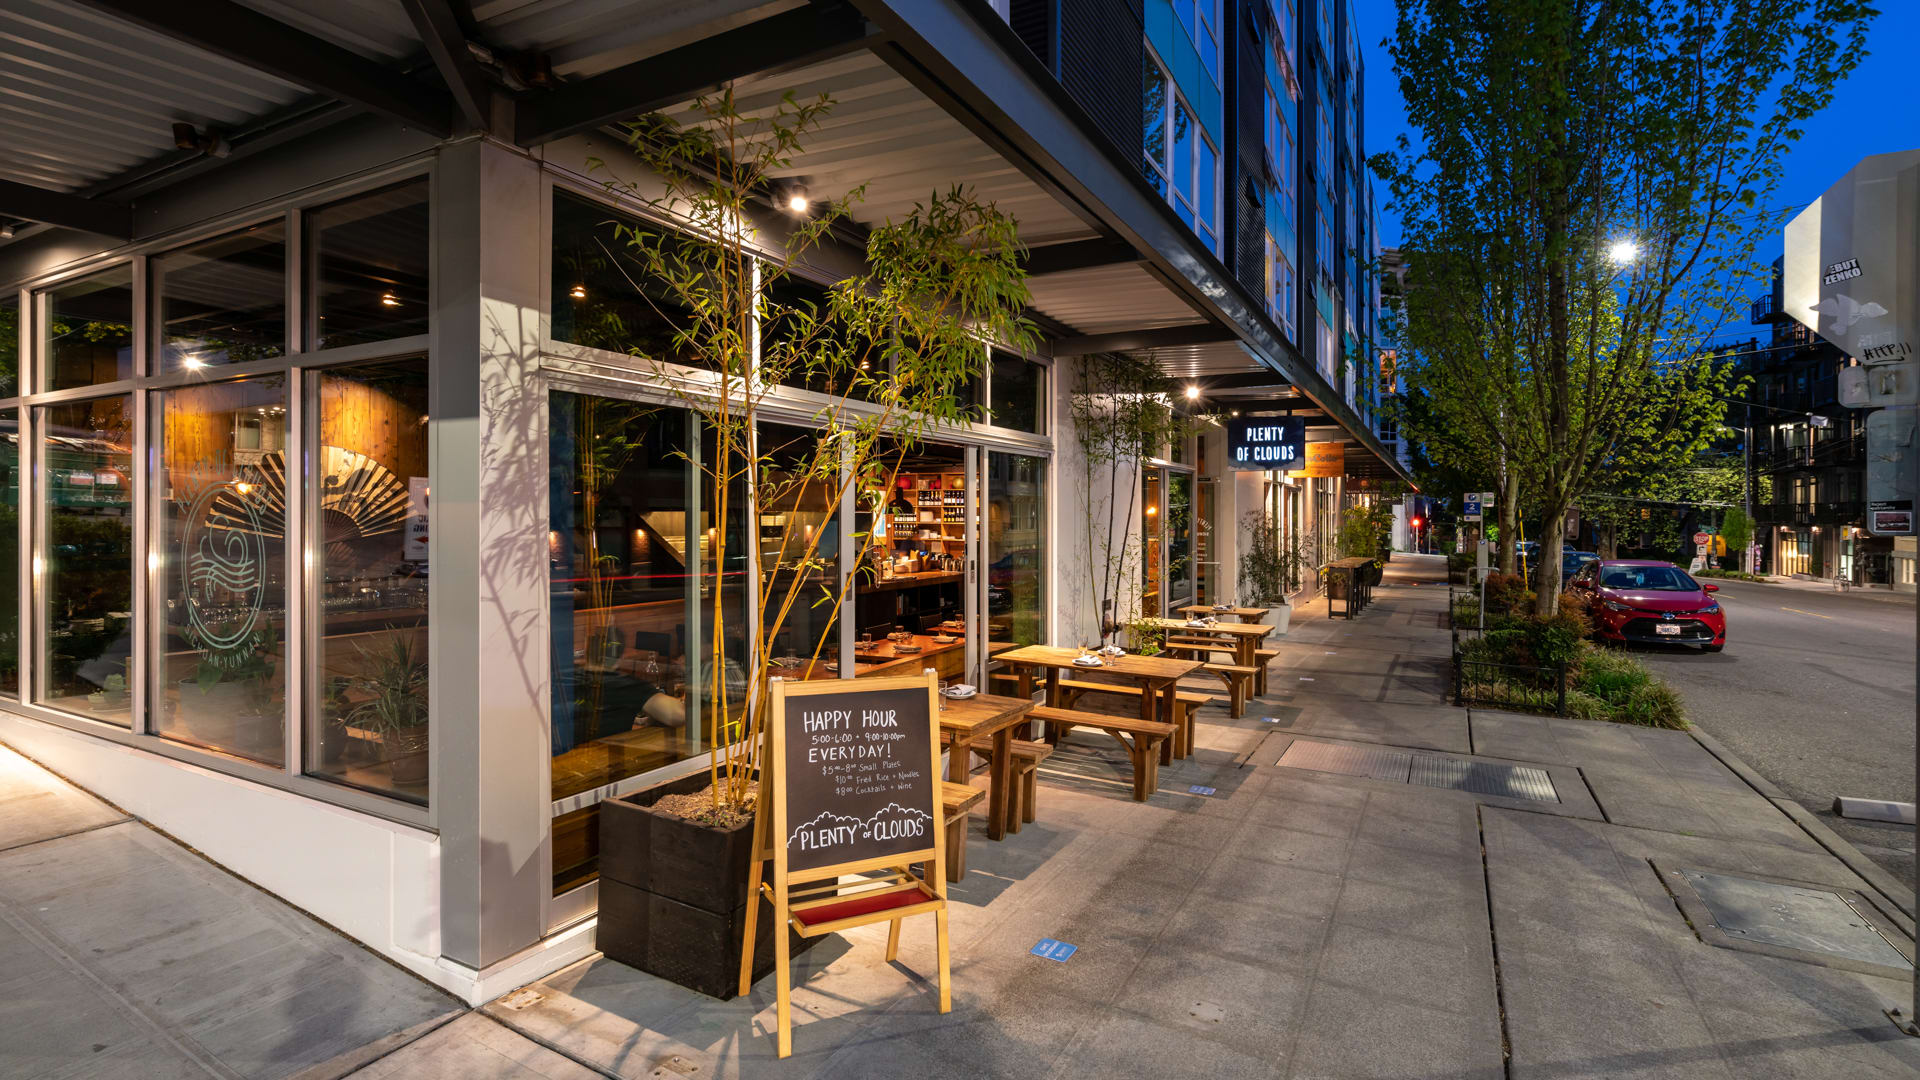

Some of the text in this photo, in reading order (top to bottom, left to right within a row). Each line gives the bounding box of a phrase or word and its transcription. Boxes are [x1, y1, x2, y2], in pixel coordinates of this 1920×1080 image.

[1826, 258, 1857, 274] EBUT
[1825, 267, 1862, 285] ZENKO
[1247, 426, 1284, 441] PLENTY
[1236, 446, 1249, 461] OF
[1254, 445, 1294, 461] CLOUDS
[215, 448, 227, 476] OF
[804, 709, 897, 733] HAPPY HOUR
[809, 743, 891, 763] EVERYDAY!
[859, 763, 877, 772] Small
[882, 760, 902, 769] Plates
[856, 776, 872, 784] Fried
[876, 773, 889, 781] Rice
[898, 771, 920, 780] Noodles
[855, 785, 886, 795] Cocktails
[800, 818, 924, 850] PLENTY OF CLOUDS
